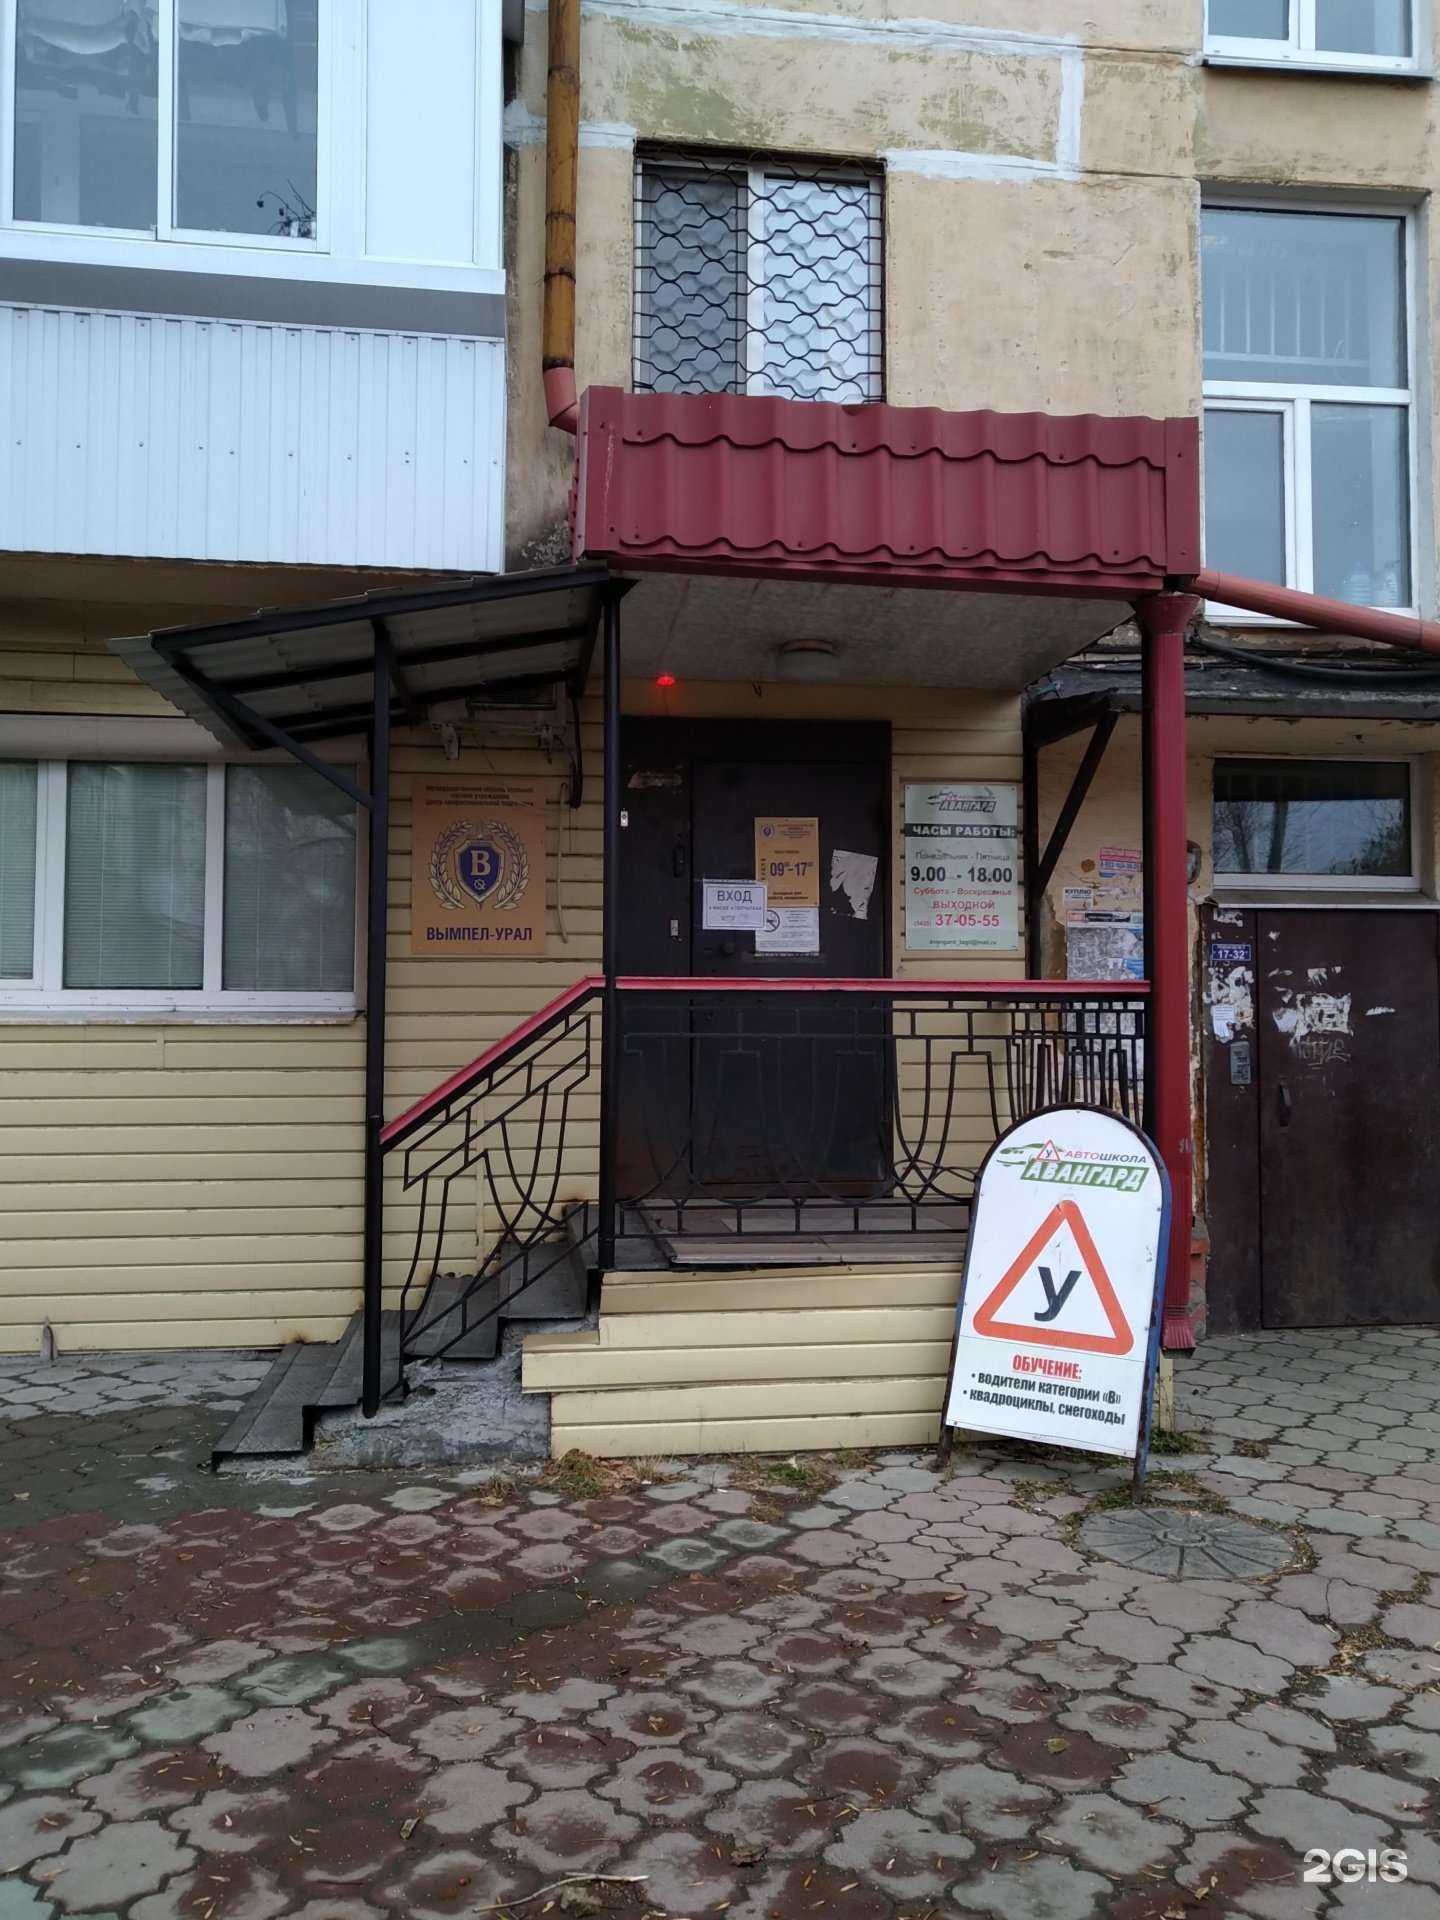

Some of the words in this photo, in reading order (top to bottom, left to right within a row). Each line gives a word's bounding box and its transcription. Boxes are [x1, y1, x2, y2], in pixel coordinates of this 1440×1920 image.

[912, 825, 951, 836] ЧАСЫ
[955, 827, 1015, 838] РАБОТЫ:
[911, 866, 946, 882] 9.00
[967, 867, 1013, 883] 18.00
[717, 890, 753, 904] ВХОД
[935, 914, 1000, 927] 37-05-55
[426, 927, 533, 941] ВЫМПЕЛ-УРАЛ
[1218, 950, 1245, 960] 17-32
[1064, 1150, 1147, 1164] АВТОШКОЛА
[1023, 1161, 1147, 1191] АВАНГАРД
[1012, 1354, 1083, 1380] ОБУЧЕНИЕ:
[977, 1372, 1037, 1392] водители
[1038, 1381, 1100, 1402] категории
[969, 1388, 1056, 1415] квадроциклы,
[1058, 1403, 1127, 1425] снегоходы
